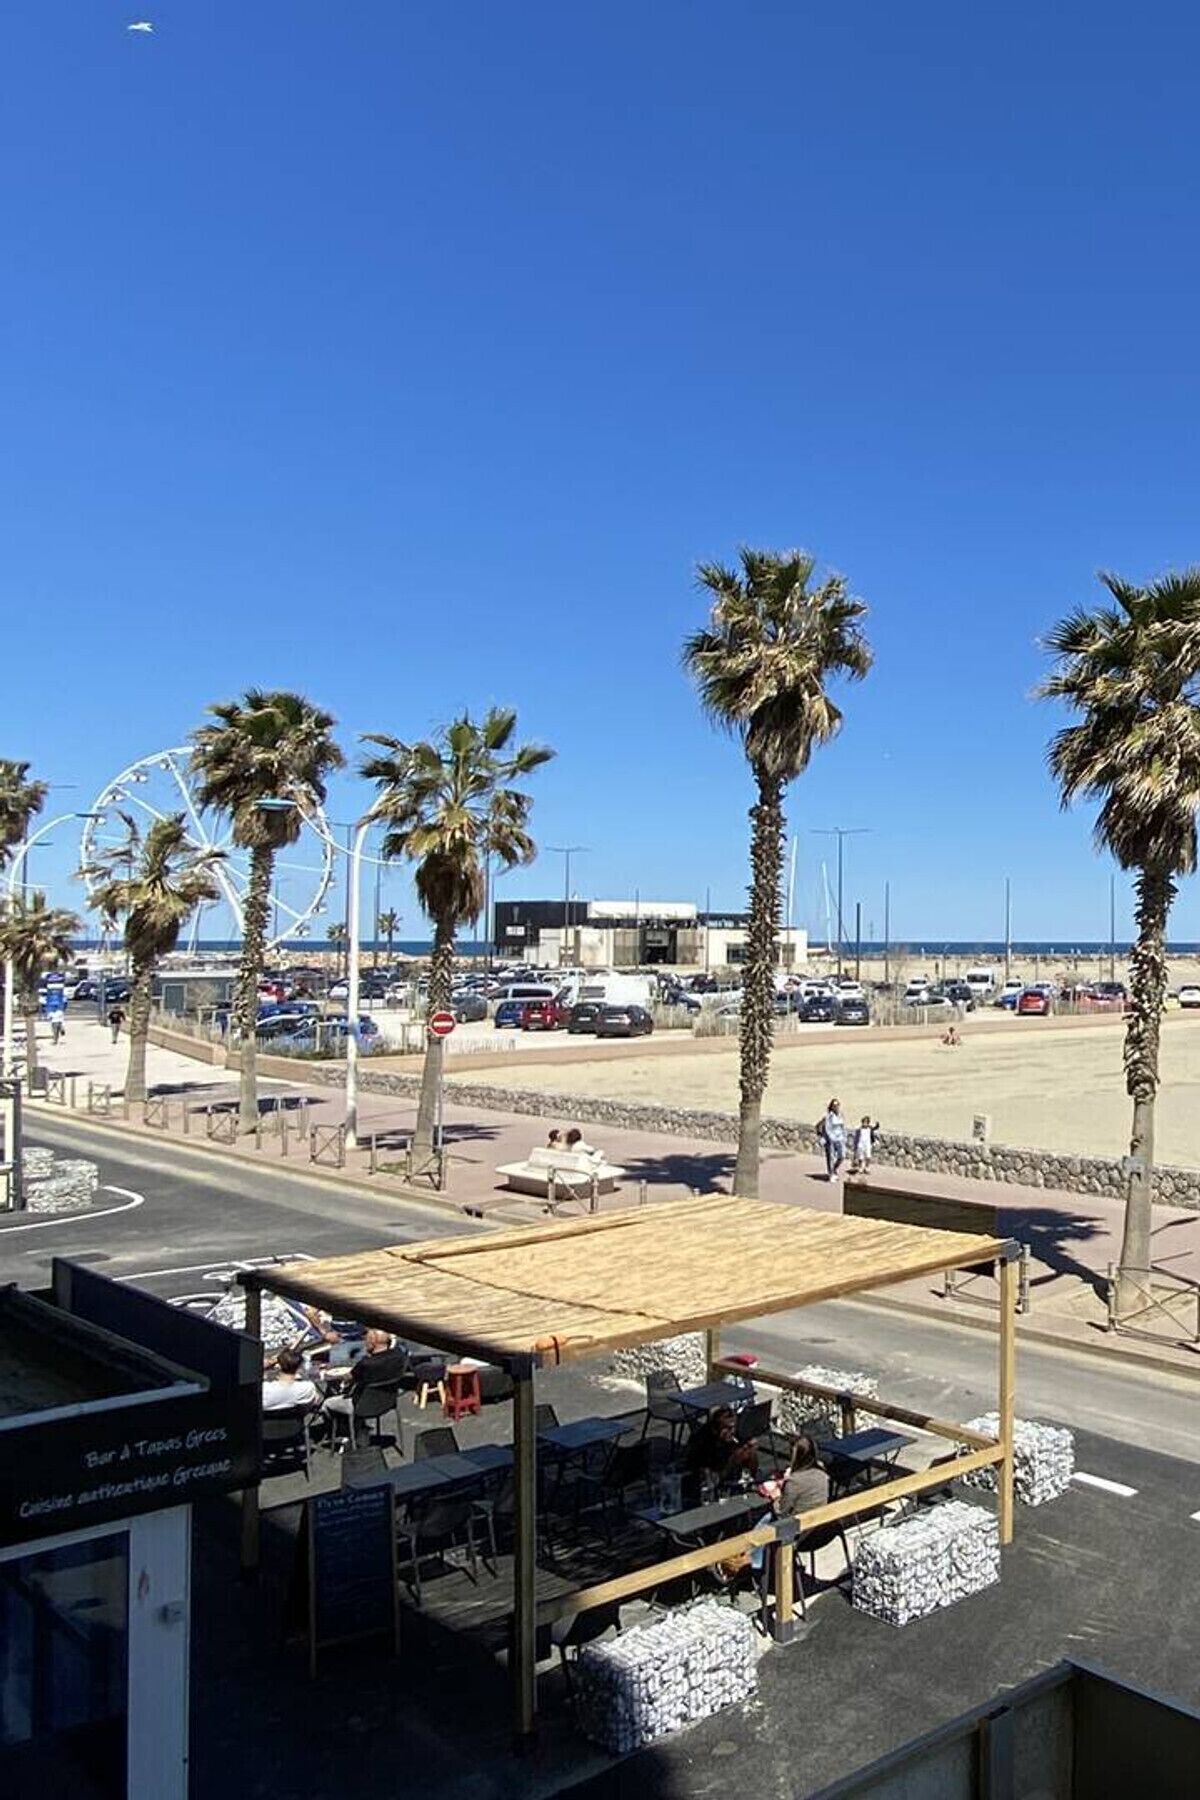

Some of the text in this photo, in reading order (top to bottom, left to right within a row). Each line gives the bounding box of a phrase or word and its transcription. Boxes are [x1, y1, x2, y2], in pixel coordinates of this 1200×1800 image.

[86, 1451, 116, 1468] Bar
[136, 1438, 183, 1456] Tapas
[19, 1494, 73, 1517] Cuisine
